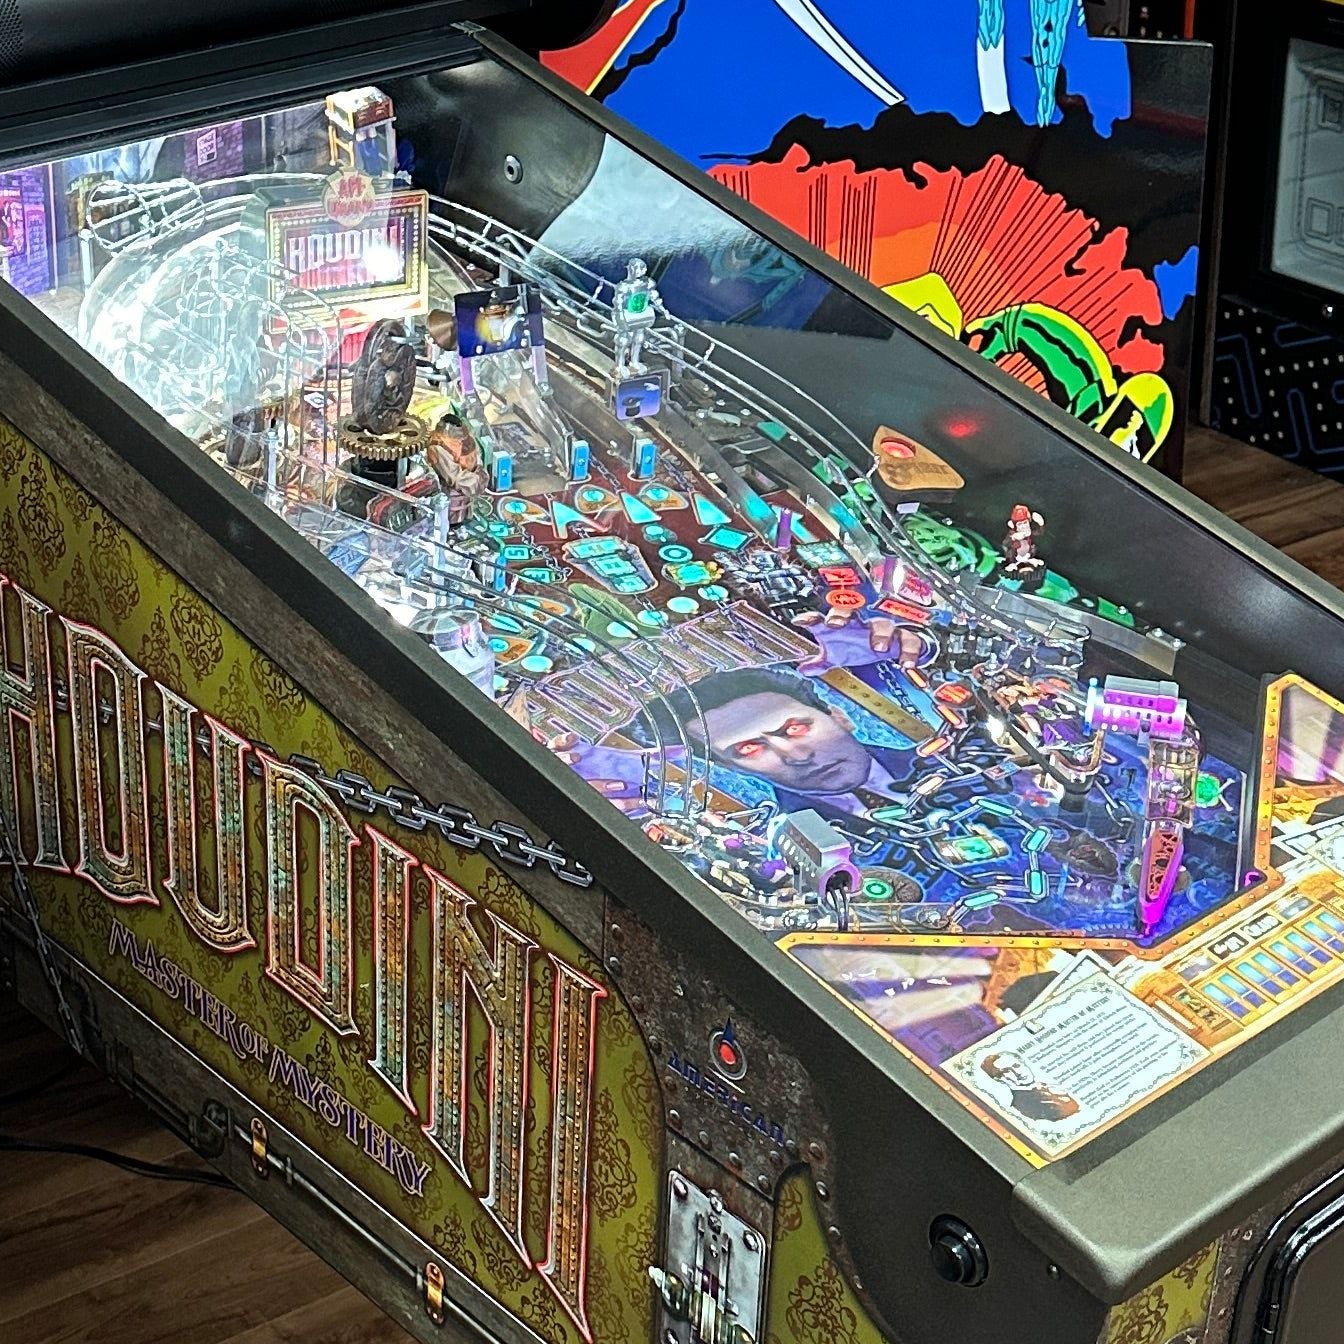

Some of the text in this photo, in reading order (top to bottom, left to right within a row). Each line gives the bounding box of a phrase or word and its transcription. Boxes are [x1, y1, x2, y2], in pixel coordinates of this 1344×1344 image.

[109, 918, 433, 1198] MASTER OF MYSTERY
